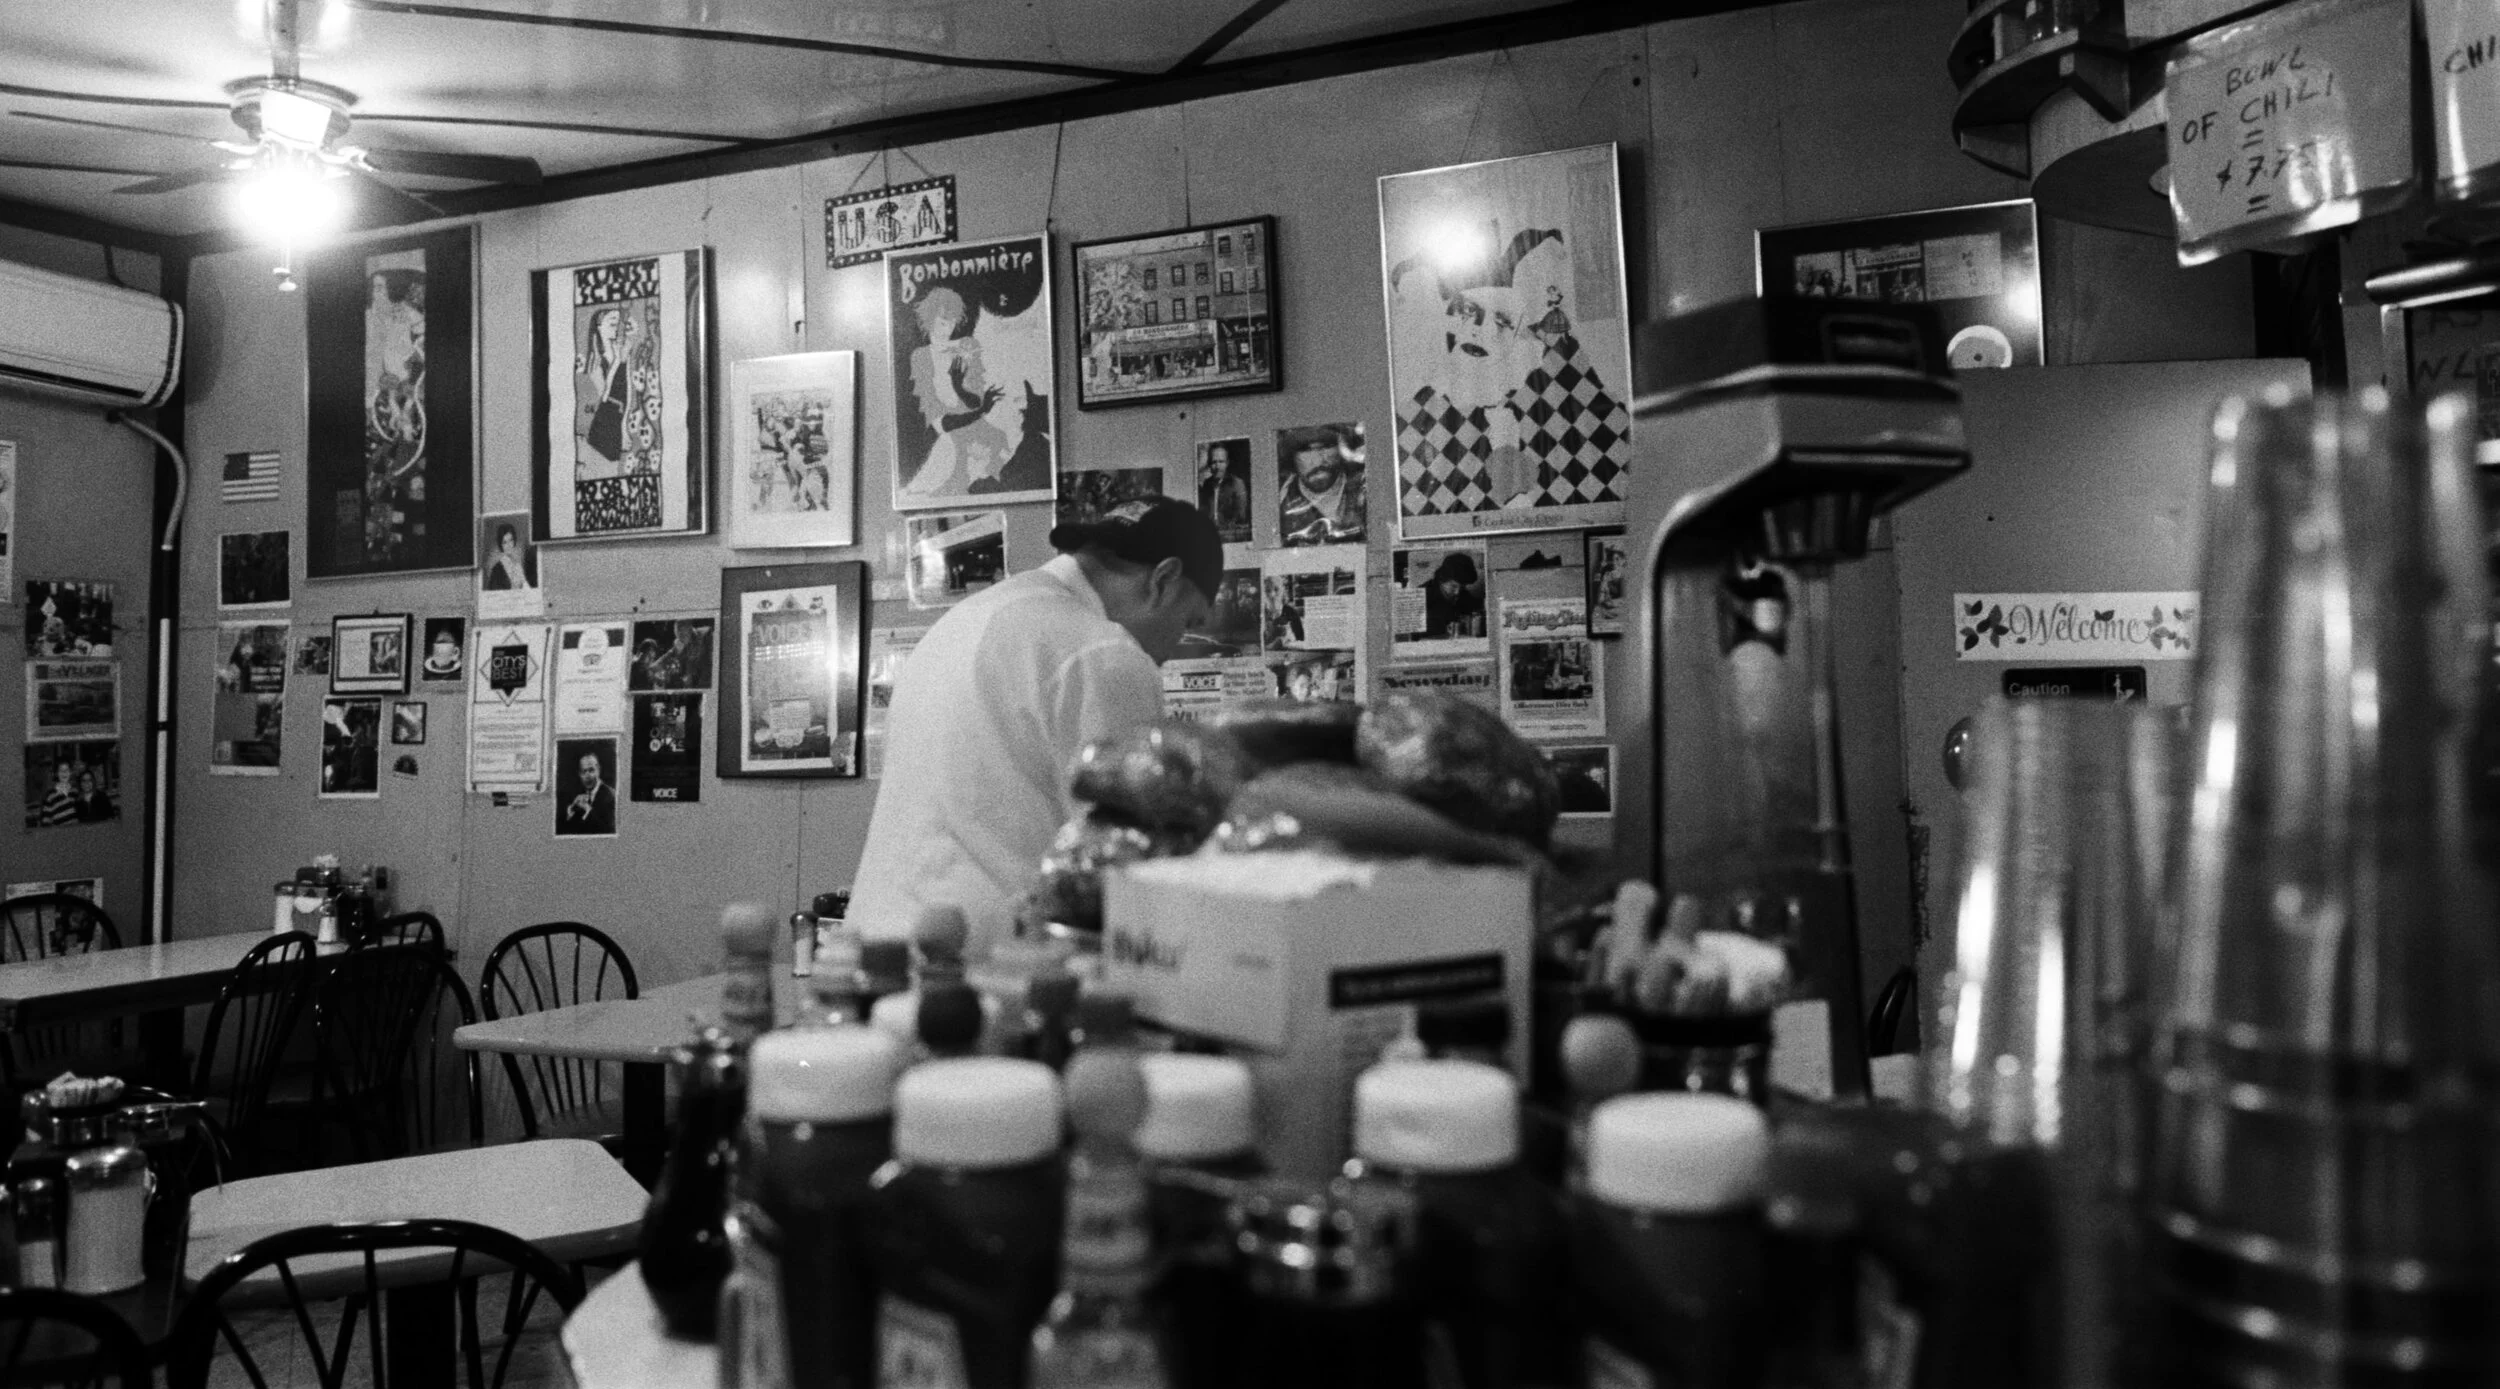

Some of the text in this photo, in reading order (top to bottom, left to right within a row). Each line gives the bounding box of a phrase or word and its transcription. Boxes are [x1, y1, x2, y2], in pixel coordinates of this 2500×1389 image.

[2227, 47, 2305, 96] BOWL
[2444, 35, 2496, 74] CHI
[2183, 72, 2333, 144] OF CHILI
[837, 194, 943, 250] USA
[2009, 602, 2150, 646] Welcome
[492, 667, 524, 681] BEST
[2008, 682, 2071, 697] Caution
[652, 788, 678, 799] VOICE
